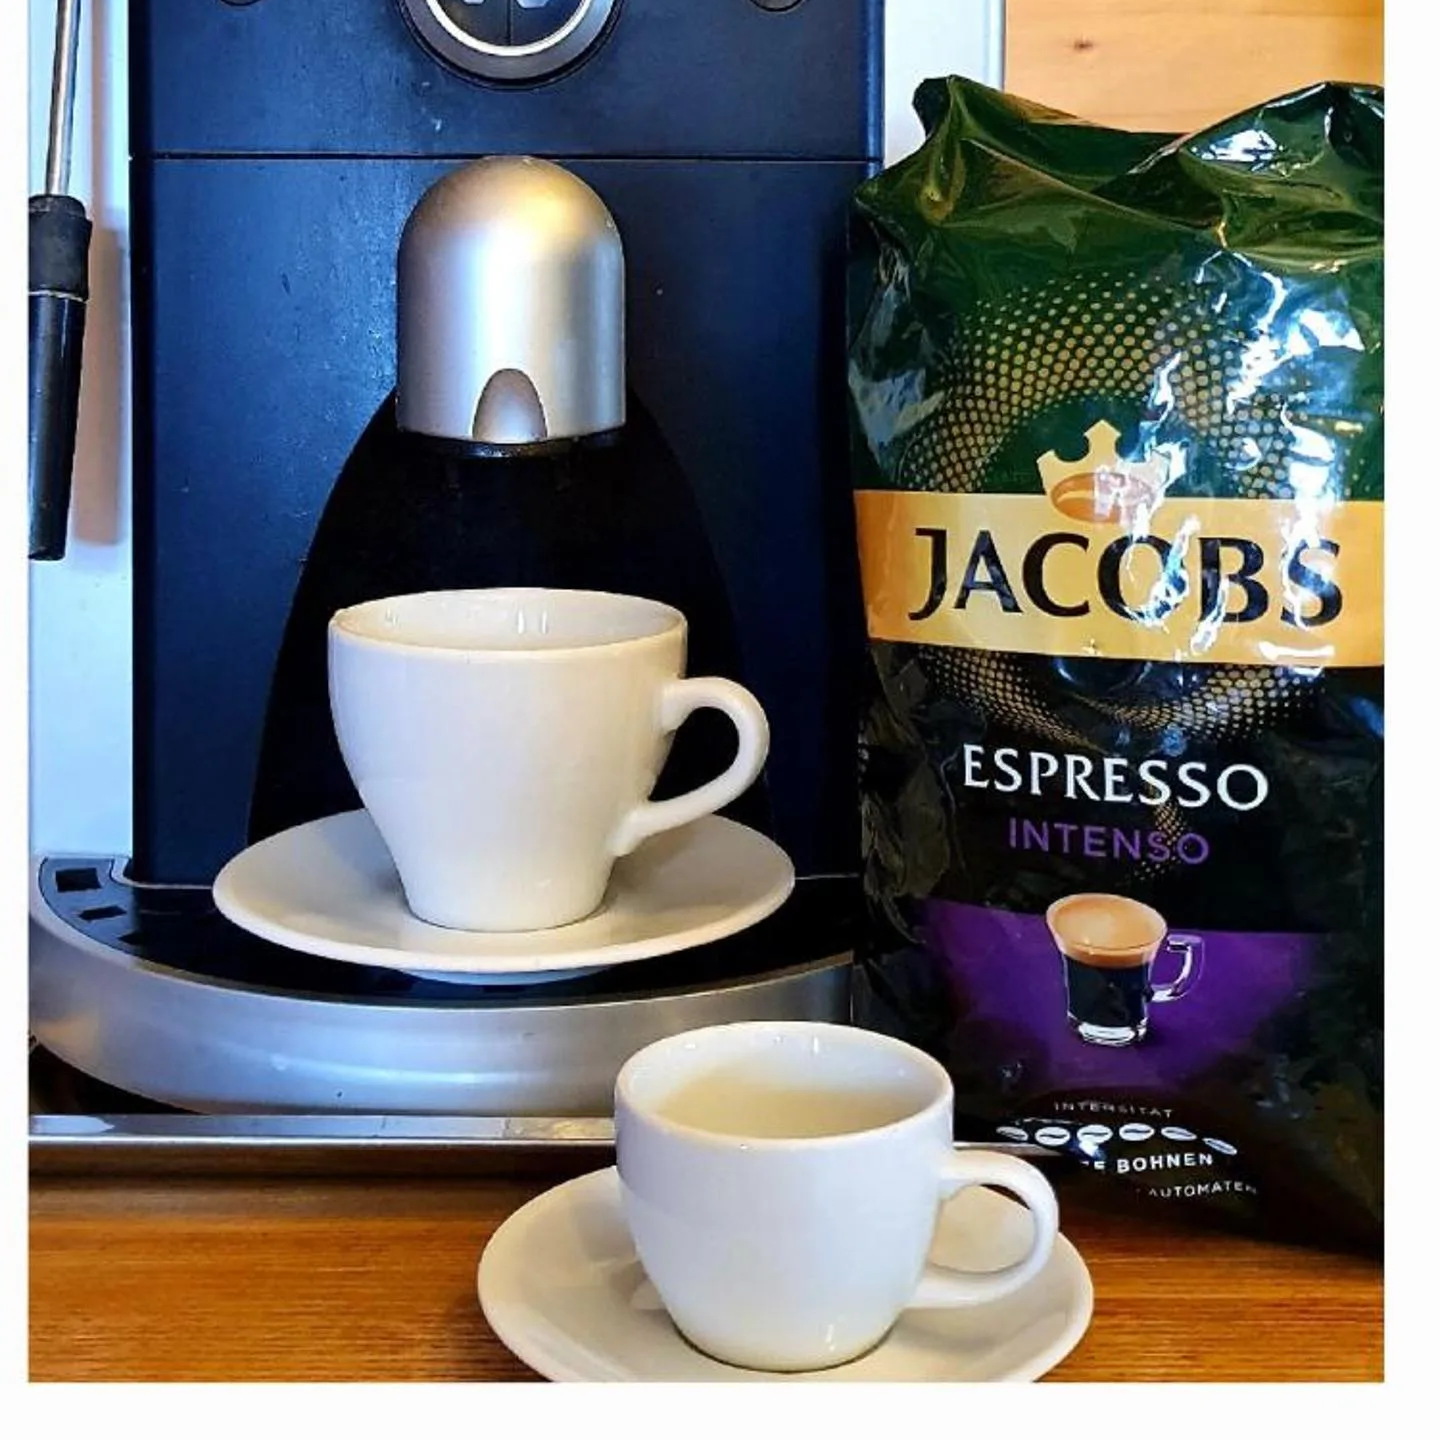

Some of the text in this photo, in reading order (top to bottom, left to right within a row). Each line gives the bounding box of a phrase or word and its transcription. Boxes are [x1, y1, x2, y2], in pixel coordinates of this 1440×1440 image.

[908, 527, 1344, 629] JACOBS
[962, 743, 1270, 812] ESPRESSO
[1008, 817, 1211, 865] INTENSO
[1117, 1152, 1214, 1175] BOHNEN
